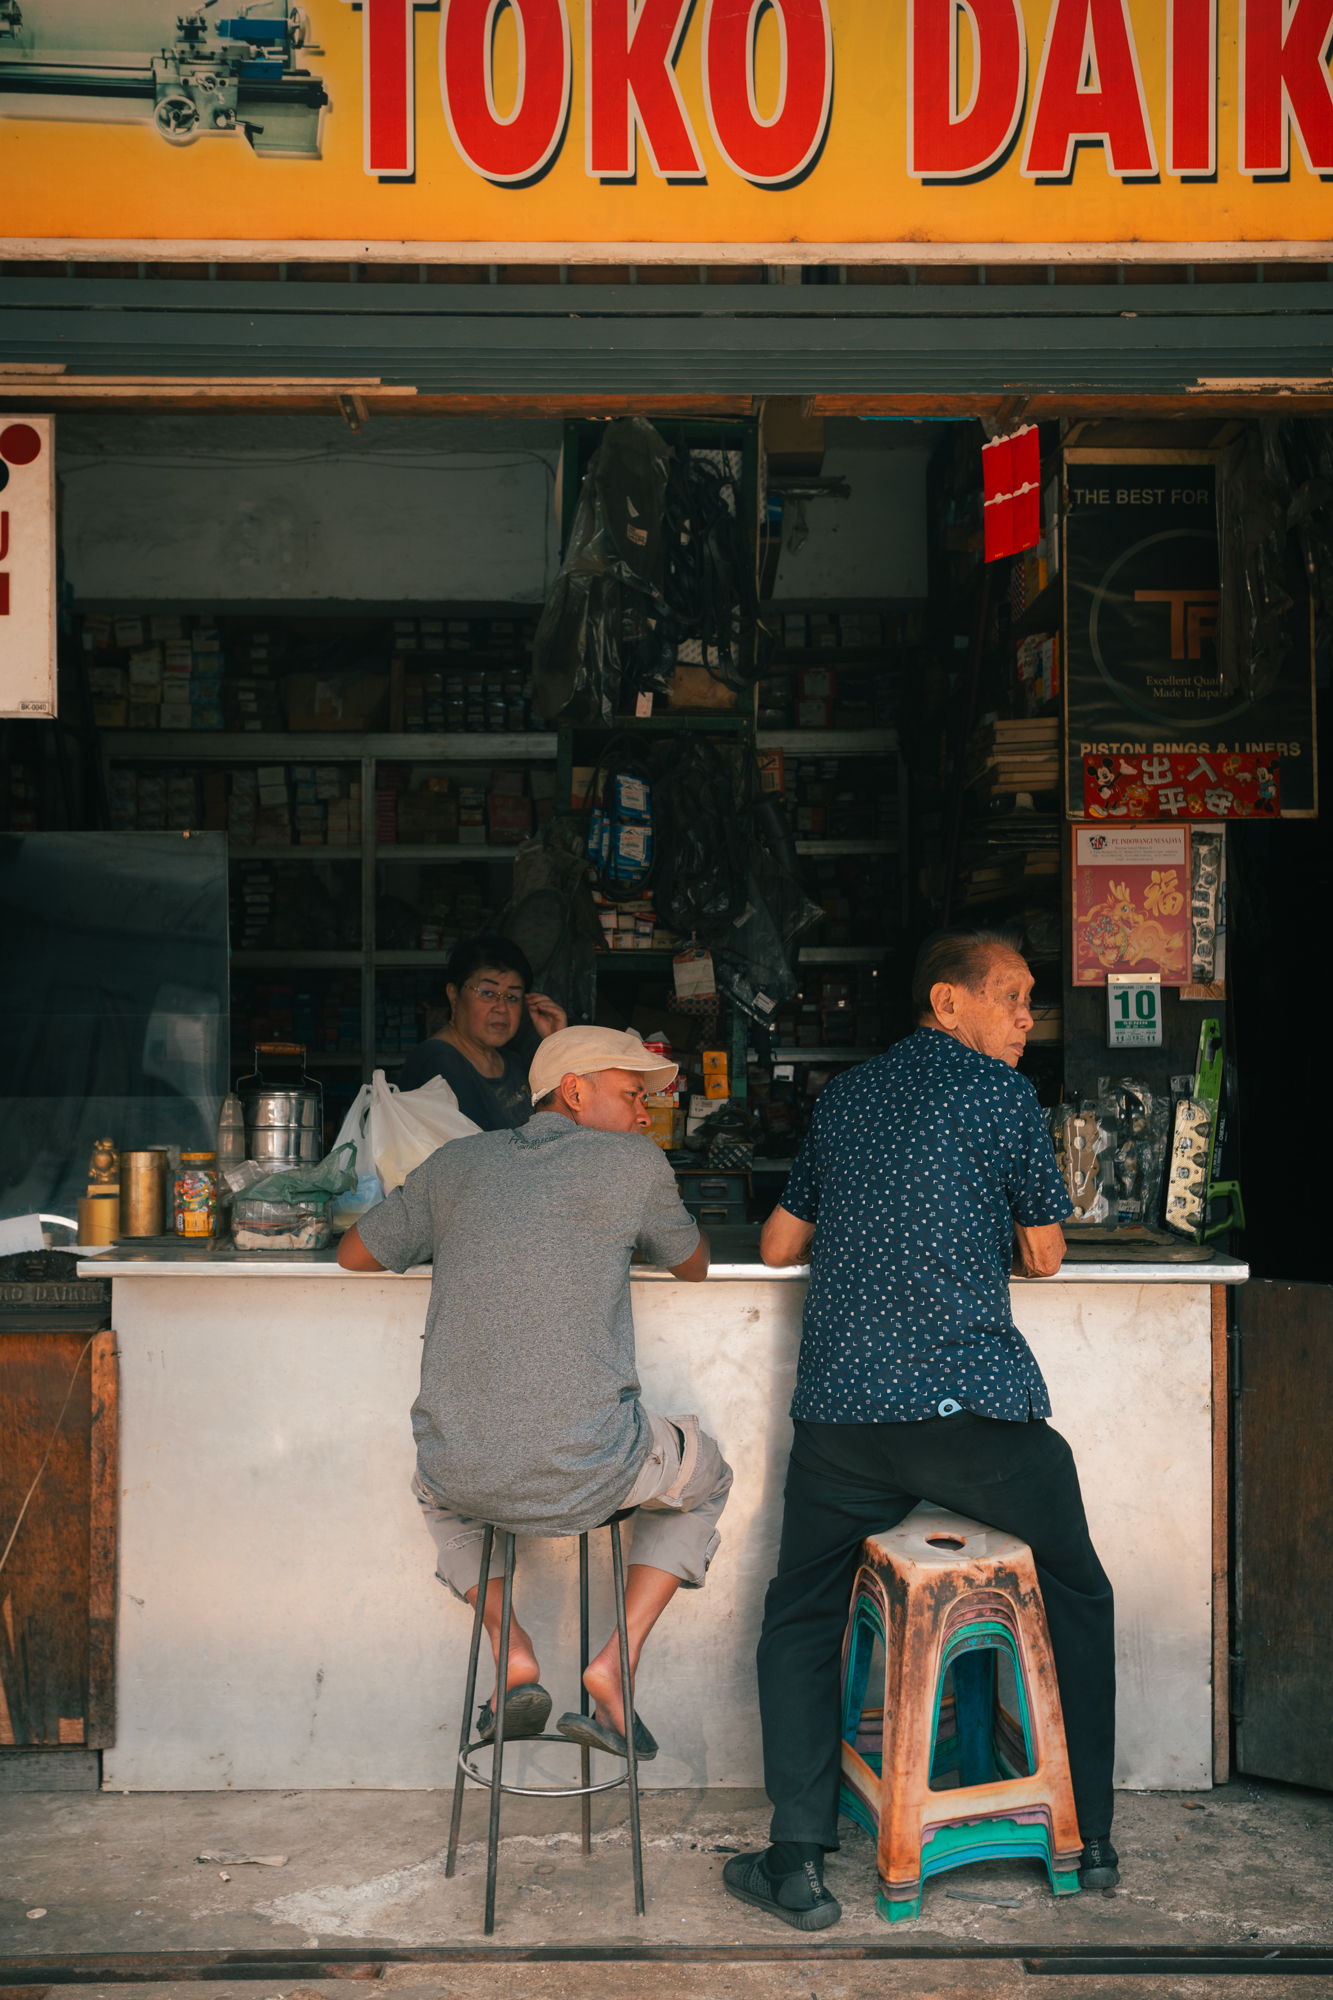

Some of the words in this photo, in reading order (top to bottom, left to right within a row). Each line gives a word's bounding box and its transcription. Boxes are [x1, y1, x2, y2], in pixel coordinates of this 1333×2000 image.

[339, 0, 833, 189] TOKO
[1074, 488, 1110, 504] THE
[1116, 488, 1165, 504] BEST
[1171, 488, 1209, 504] FOR
[1146, 675, 1192, 686] Excellent
[1153, 687, 1182, 698] Made
[1184, 687, 1195, 698] In
[21, 703, 47, 711] BK-0040
[1080, 742, 1147, 757] PISTON
[1143, 869, 1184, 917] 福
[1114, 990, 1156, 1020] 10
